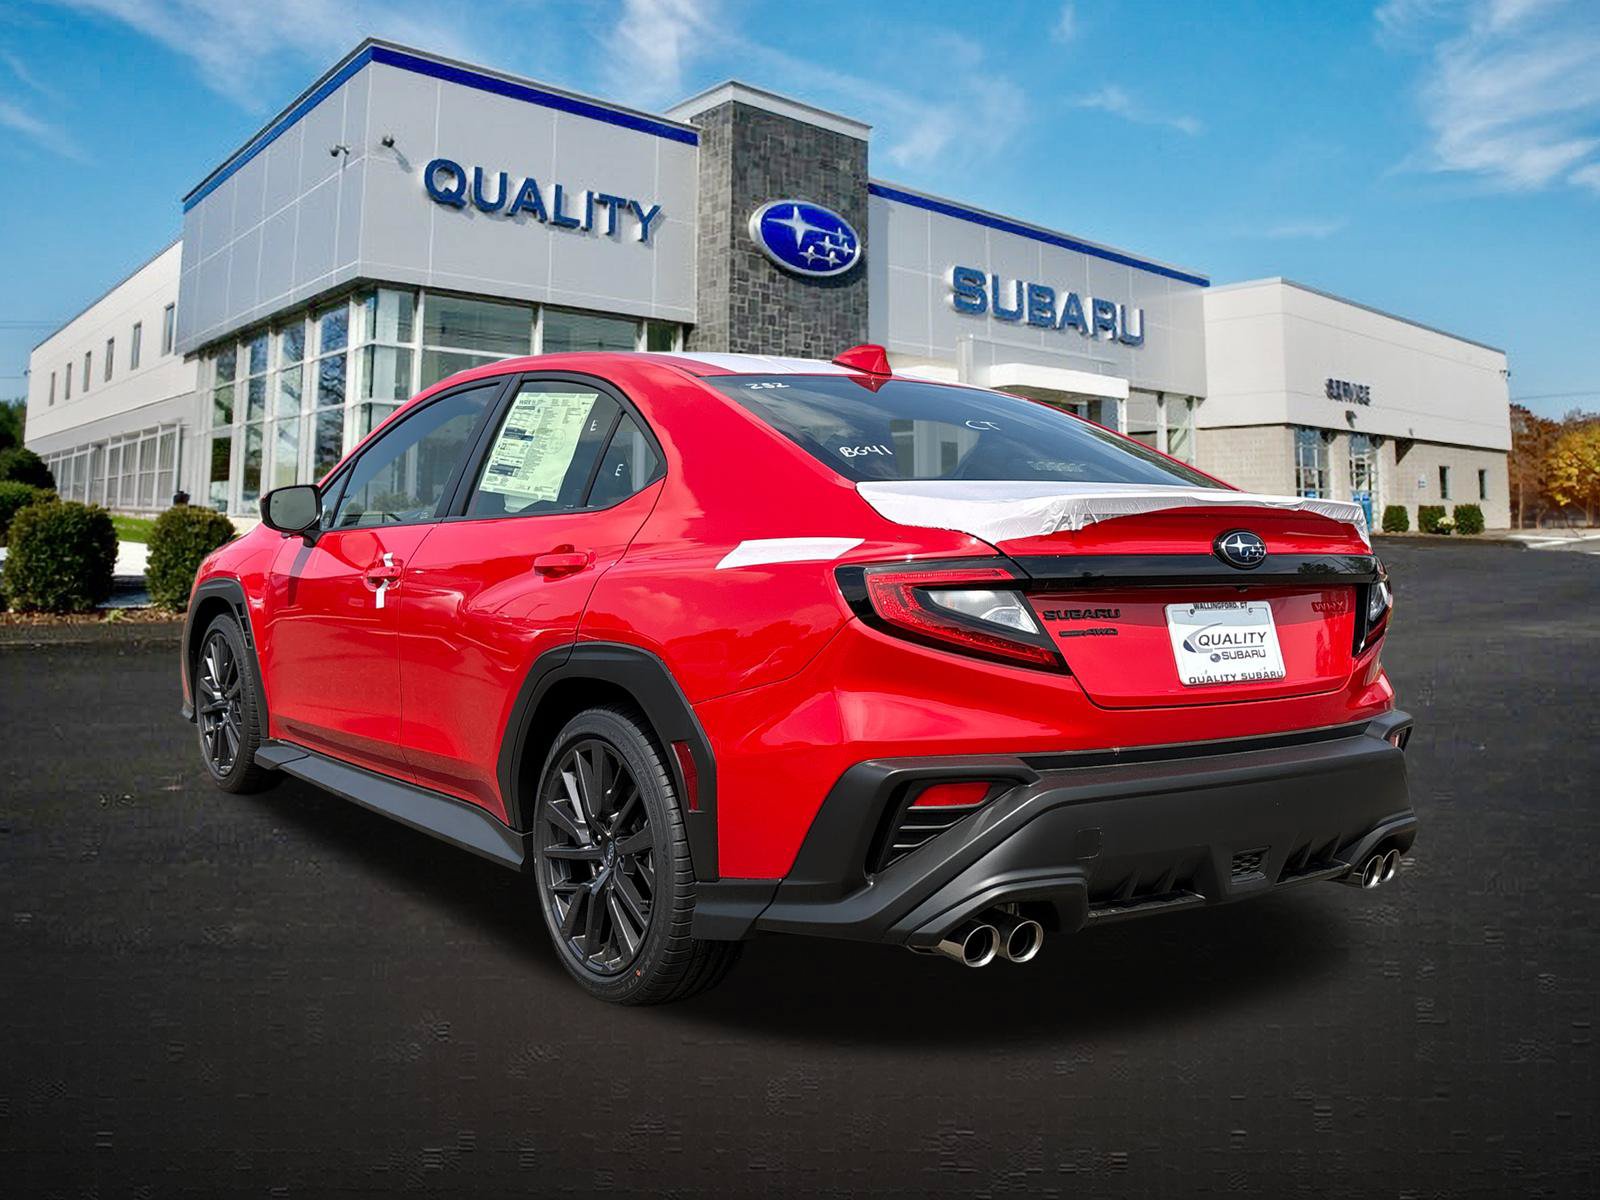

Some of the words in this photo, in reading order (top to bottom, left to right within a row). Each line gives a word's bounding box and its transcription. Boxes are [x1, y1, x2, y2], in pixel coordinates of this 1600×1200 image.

[424, 158, 662, 243] QUALITY
[950, 265, 1145, 347] SUBARU
[1043, 608, 1121, 620] SUBARU
[1198, 631, 1267, 647] QUALITY
[1221, 649, 1267, 661] SUBARU
[1188, 673, 1237, 685] QUALITY
[1241, 670, 1284, 681] SUBARU
